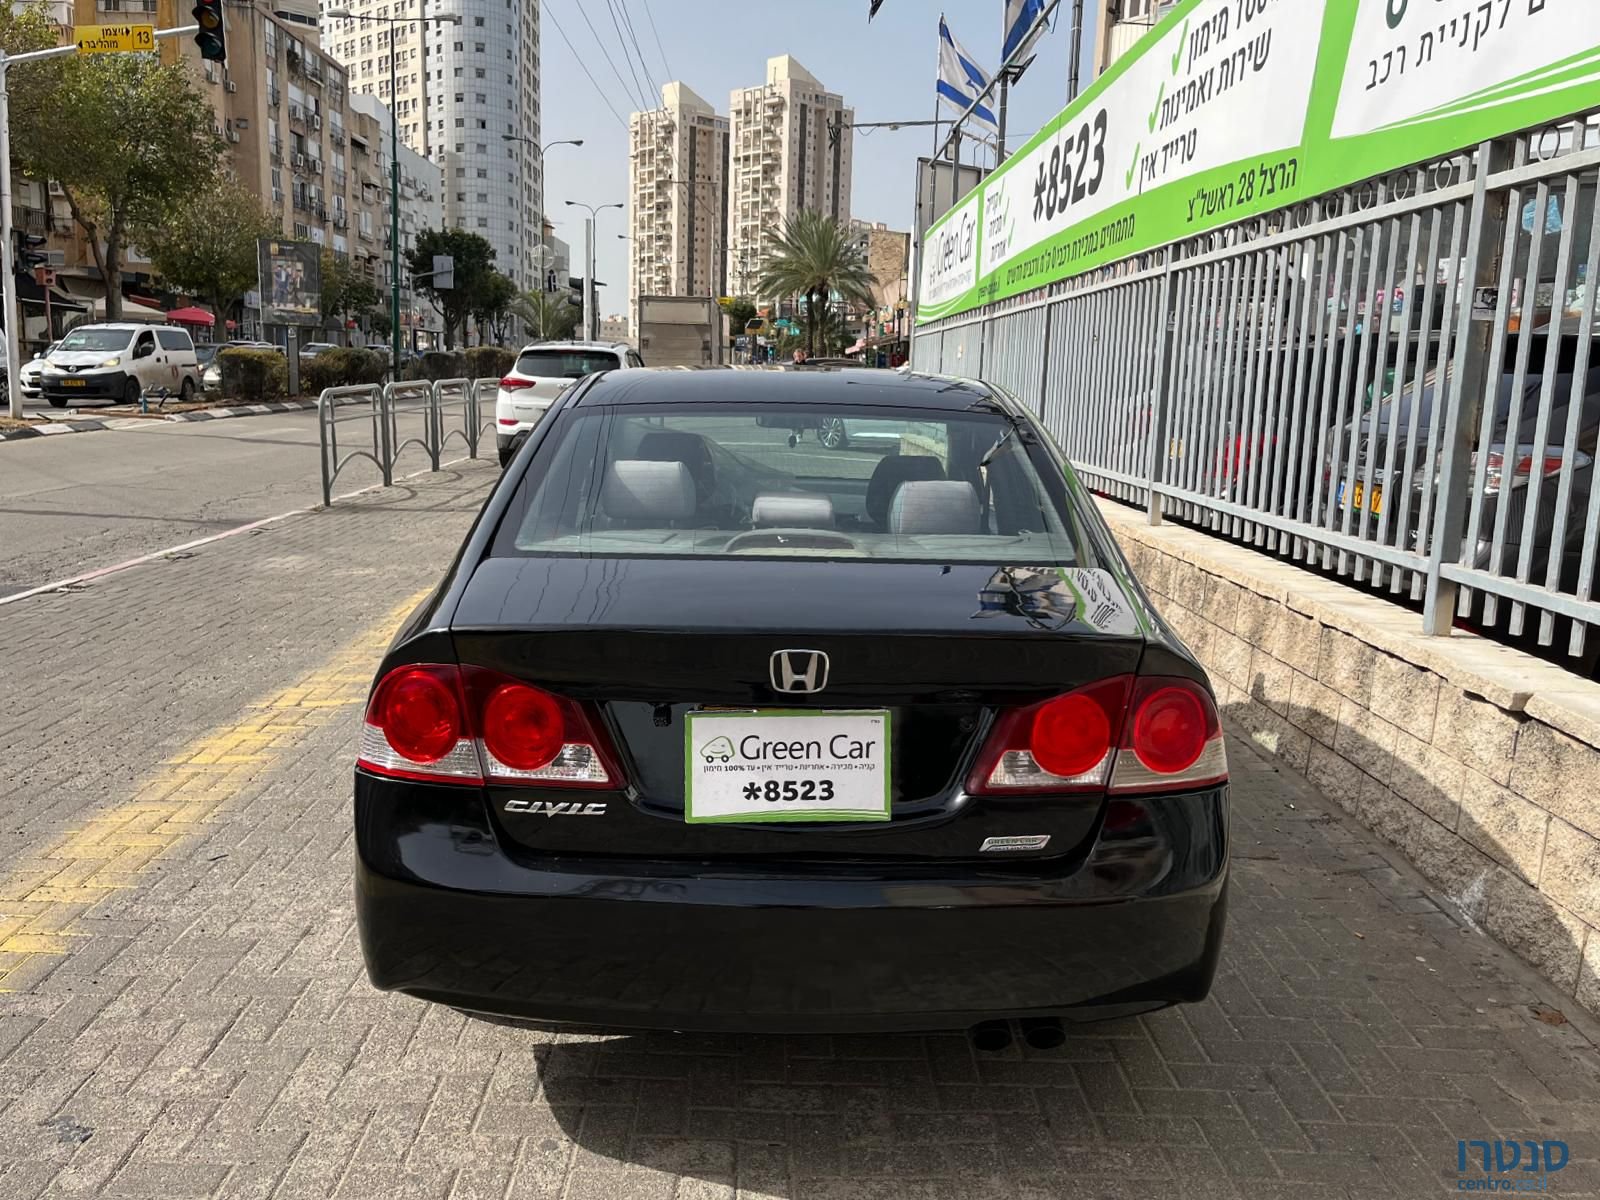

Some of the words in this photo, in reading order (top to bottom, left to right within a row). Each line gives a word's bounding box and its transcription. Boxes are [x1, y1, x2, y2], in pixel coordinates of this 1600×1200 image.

[85, 38, 118, 48] מוהליבר
[101, 27, 124, 39] ויצמן
[136, 31, 150, 44] 13
[1187, 6, 1229, 75] מימון
[1216, 28, 1272, 96] שירות
[1365, 45, 1406, 91] רכב
[1160, 67, 1215, 131] ואמינות
[1162, 128, 1197, 175] טרייד
[1138, 149, 1159, 195] אין
[1236, 168, 1255, 206] 28
[1259, 158, 1298, 198] הרצל
[960, 211, 977, 263] Car
[1100, 213, 1135, 250] מתמחים
[740, 734, 821, 760] Green
[829, 734, 876, 759] Car
[503, 799, 607, 818] CIVIC
